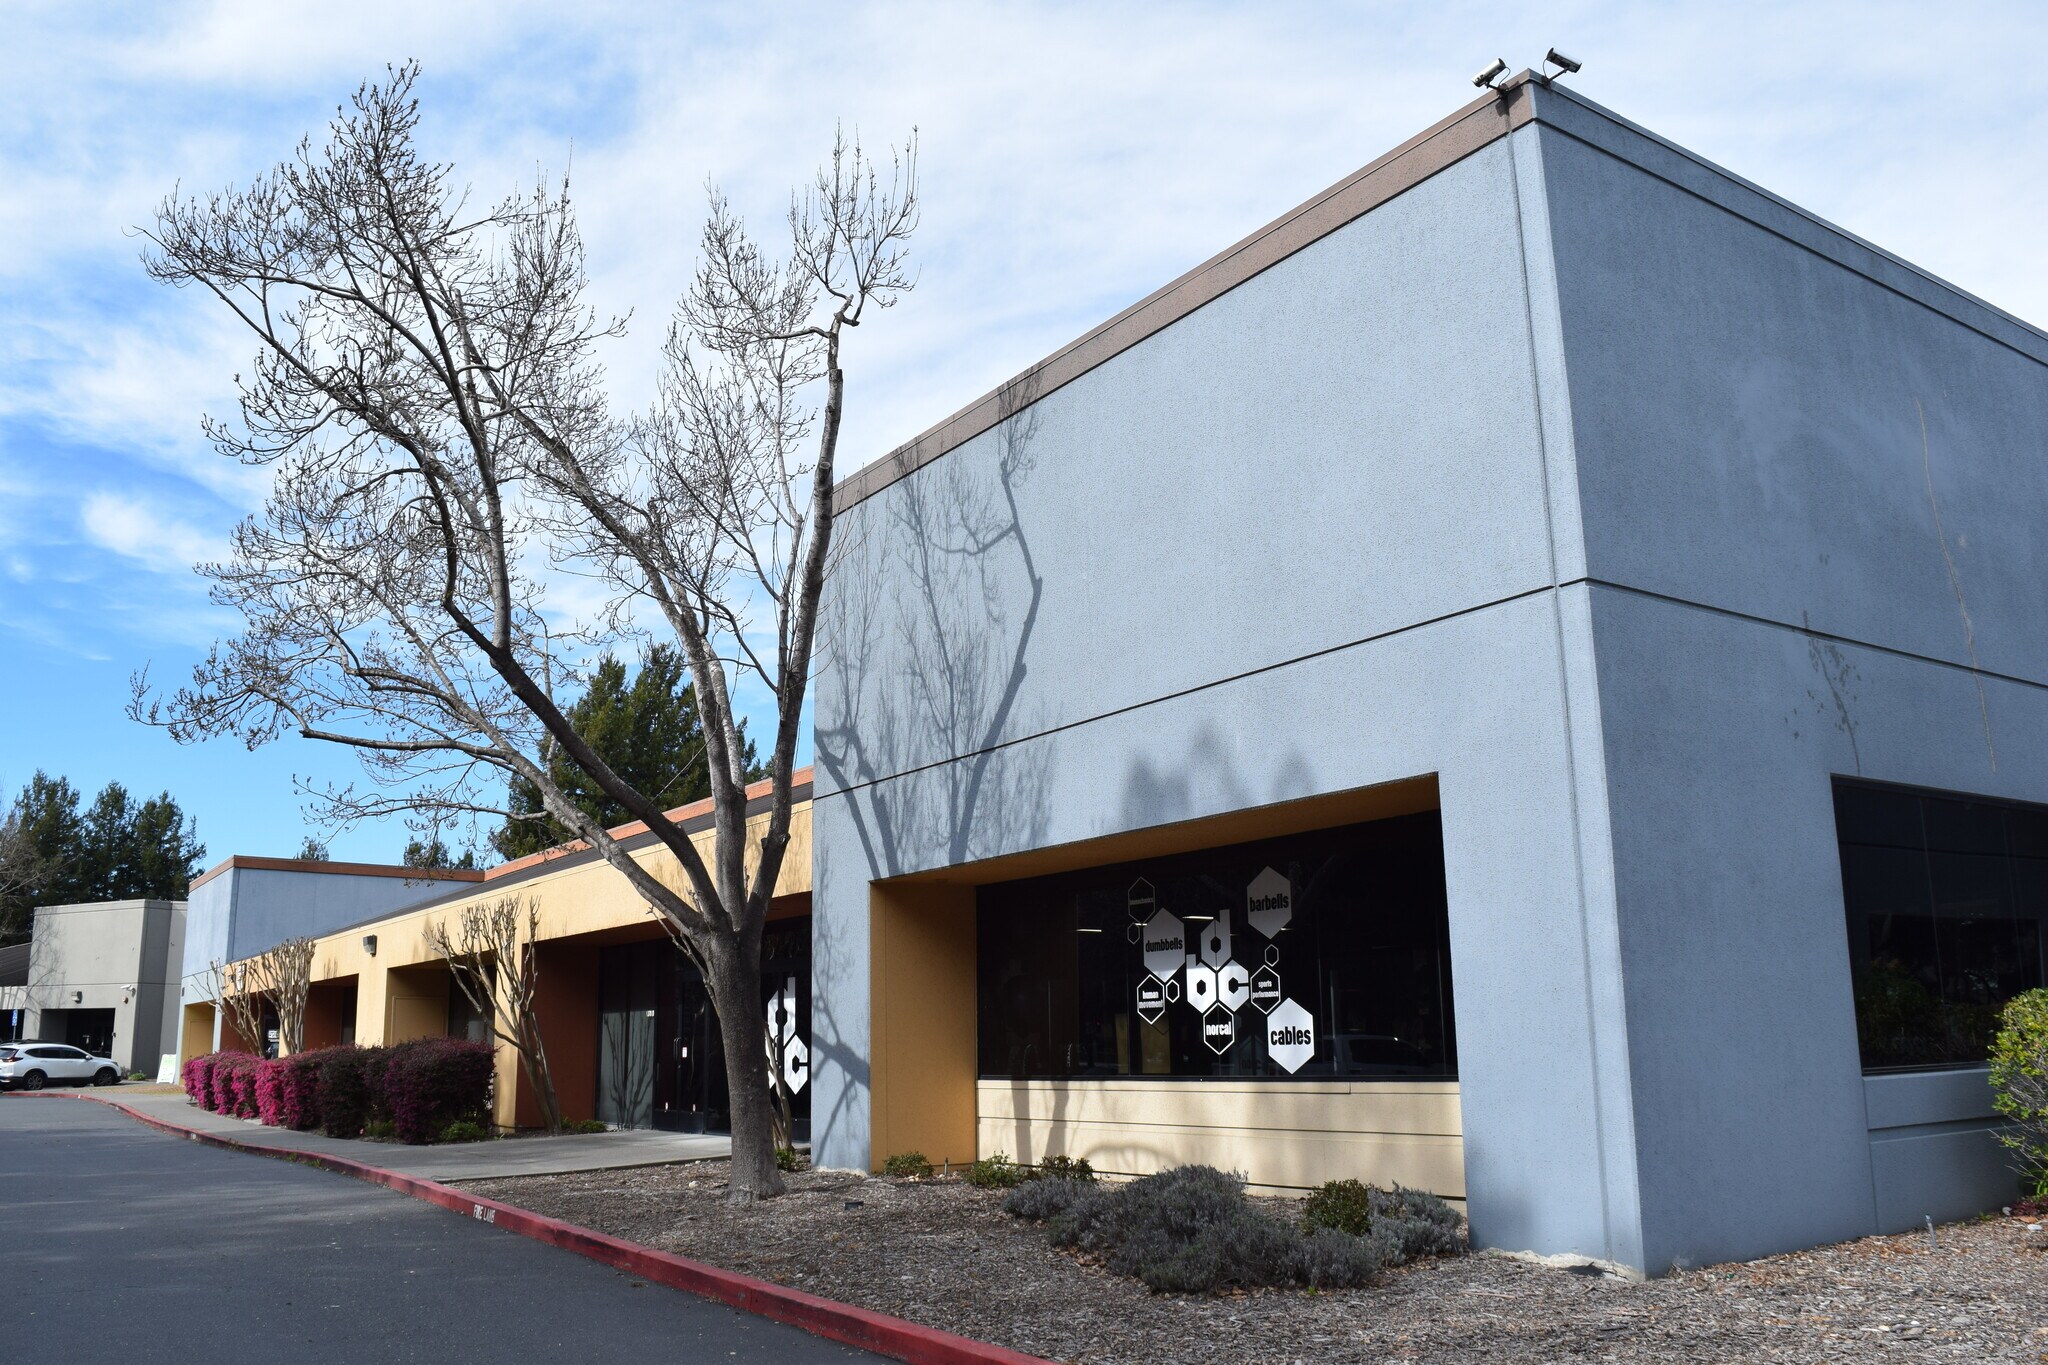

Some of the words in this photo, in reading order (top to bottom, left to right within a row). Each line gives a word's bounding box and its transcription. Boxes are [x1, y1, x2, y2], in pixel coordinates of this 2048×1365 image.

[1250, 893, 1289, 912] barbells
[1145, 936, 1183, 952] dumbbells
[1258, 980, 1272, 988] sports
[1142, 990, 1159, 999] human
[1252, 990, 1278, 999] performance
[1138, 999, 1163, 1009] movement
[1206, 1021, 1231, 1036] norcal
[1271, 1026, 1311, 1046] cables
